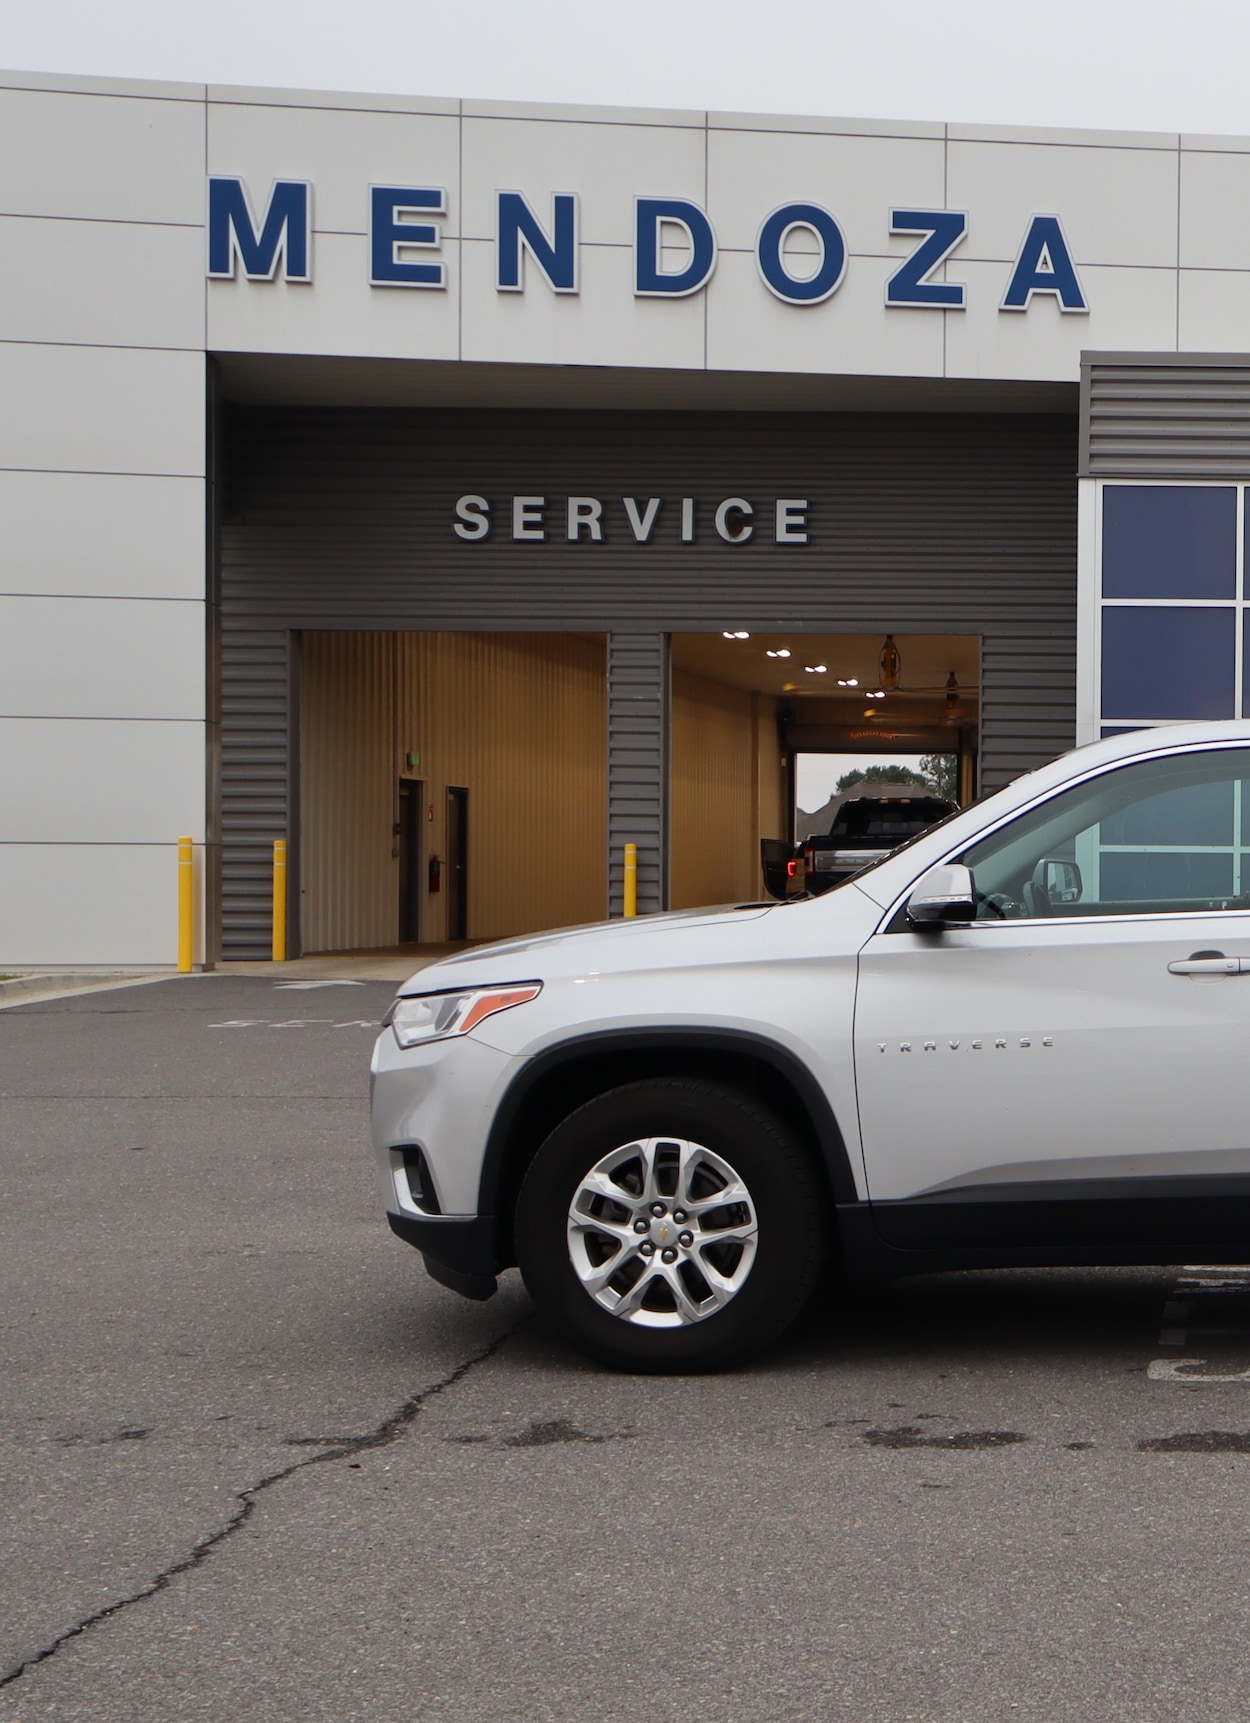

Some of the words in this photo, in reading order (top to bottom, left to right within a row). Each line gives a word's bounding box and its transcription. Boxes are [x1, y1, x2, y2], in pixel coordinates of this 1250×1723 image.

[205, 174, 1091, 314] MENDOZA
[452, 494, 811, 545] SERVICE
[877, 1036, 1054, 1053] TRAVERSE
